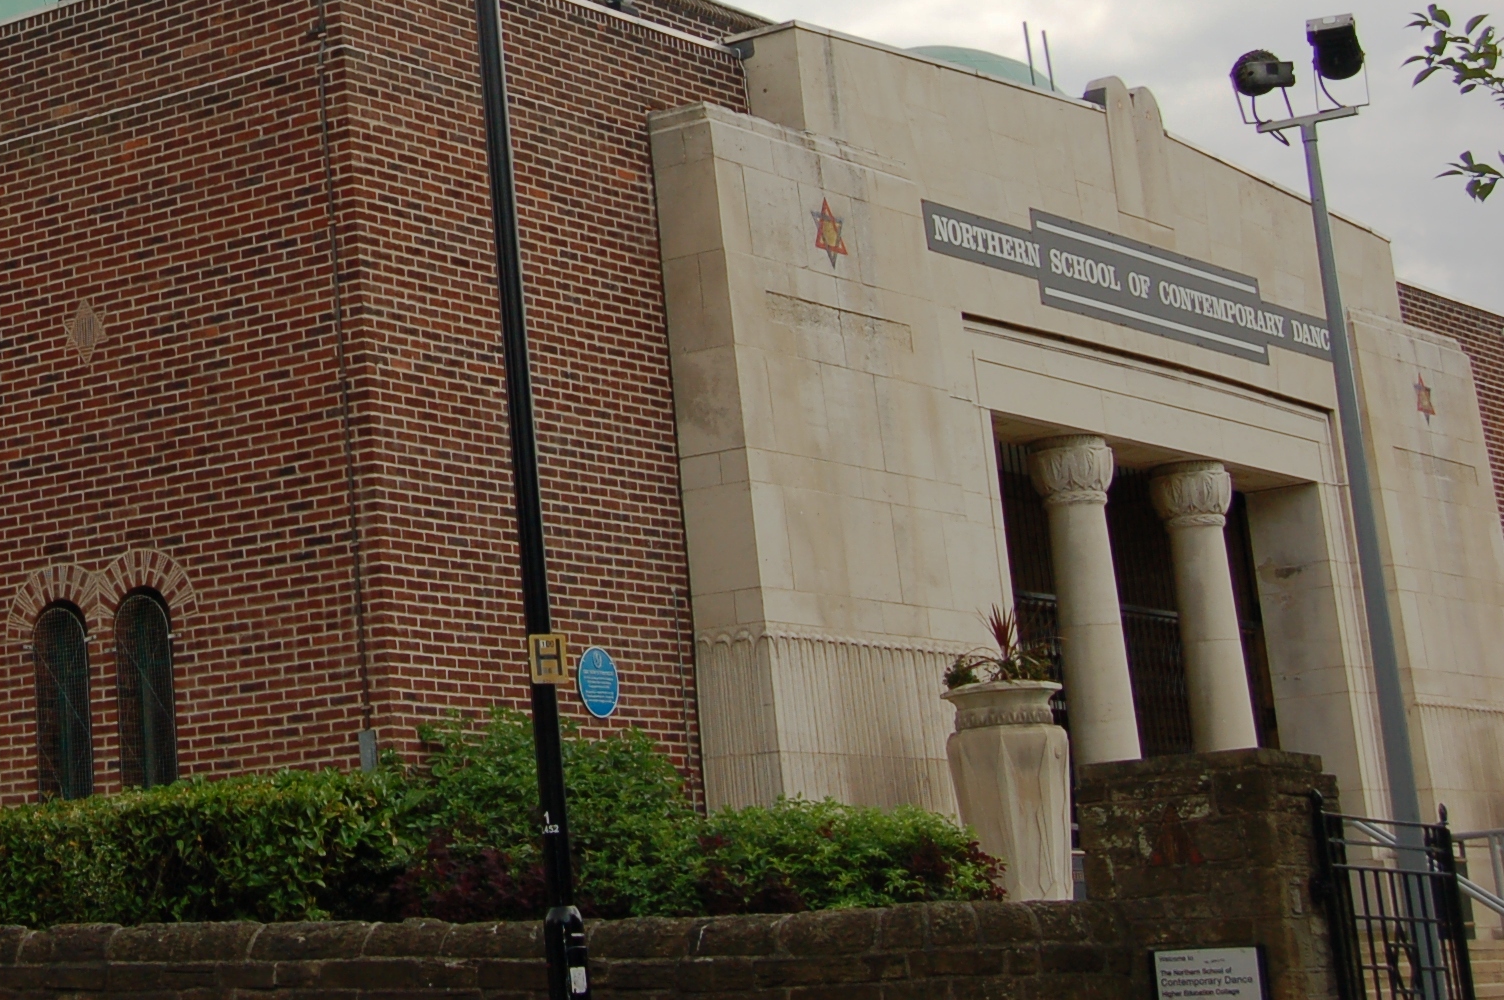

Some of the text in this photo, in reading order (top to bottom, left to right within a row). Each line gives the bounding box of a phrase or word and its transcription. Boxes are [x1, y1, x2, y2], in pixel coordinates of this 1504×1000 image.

[932, 214, 1330, 351] NORTHERN SCHOOL OF CONTEMPORARY DANC
[543, 810, 550, 824] 1
[1202, 967, 1224, 975] School
[1161, 975, 1253, 987] Contemporary Dance
[1215, 988, 1240, 996] College
